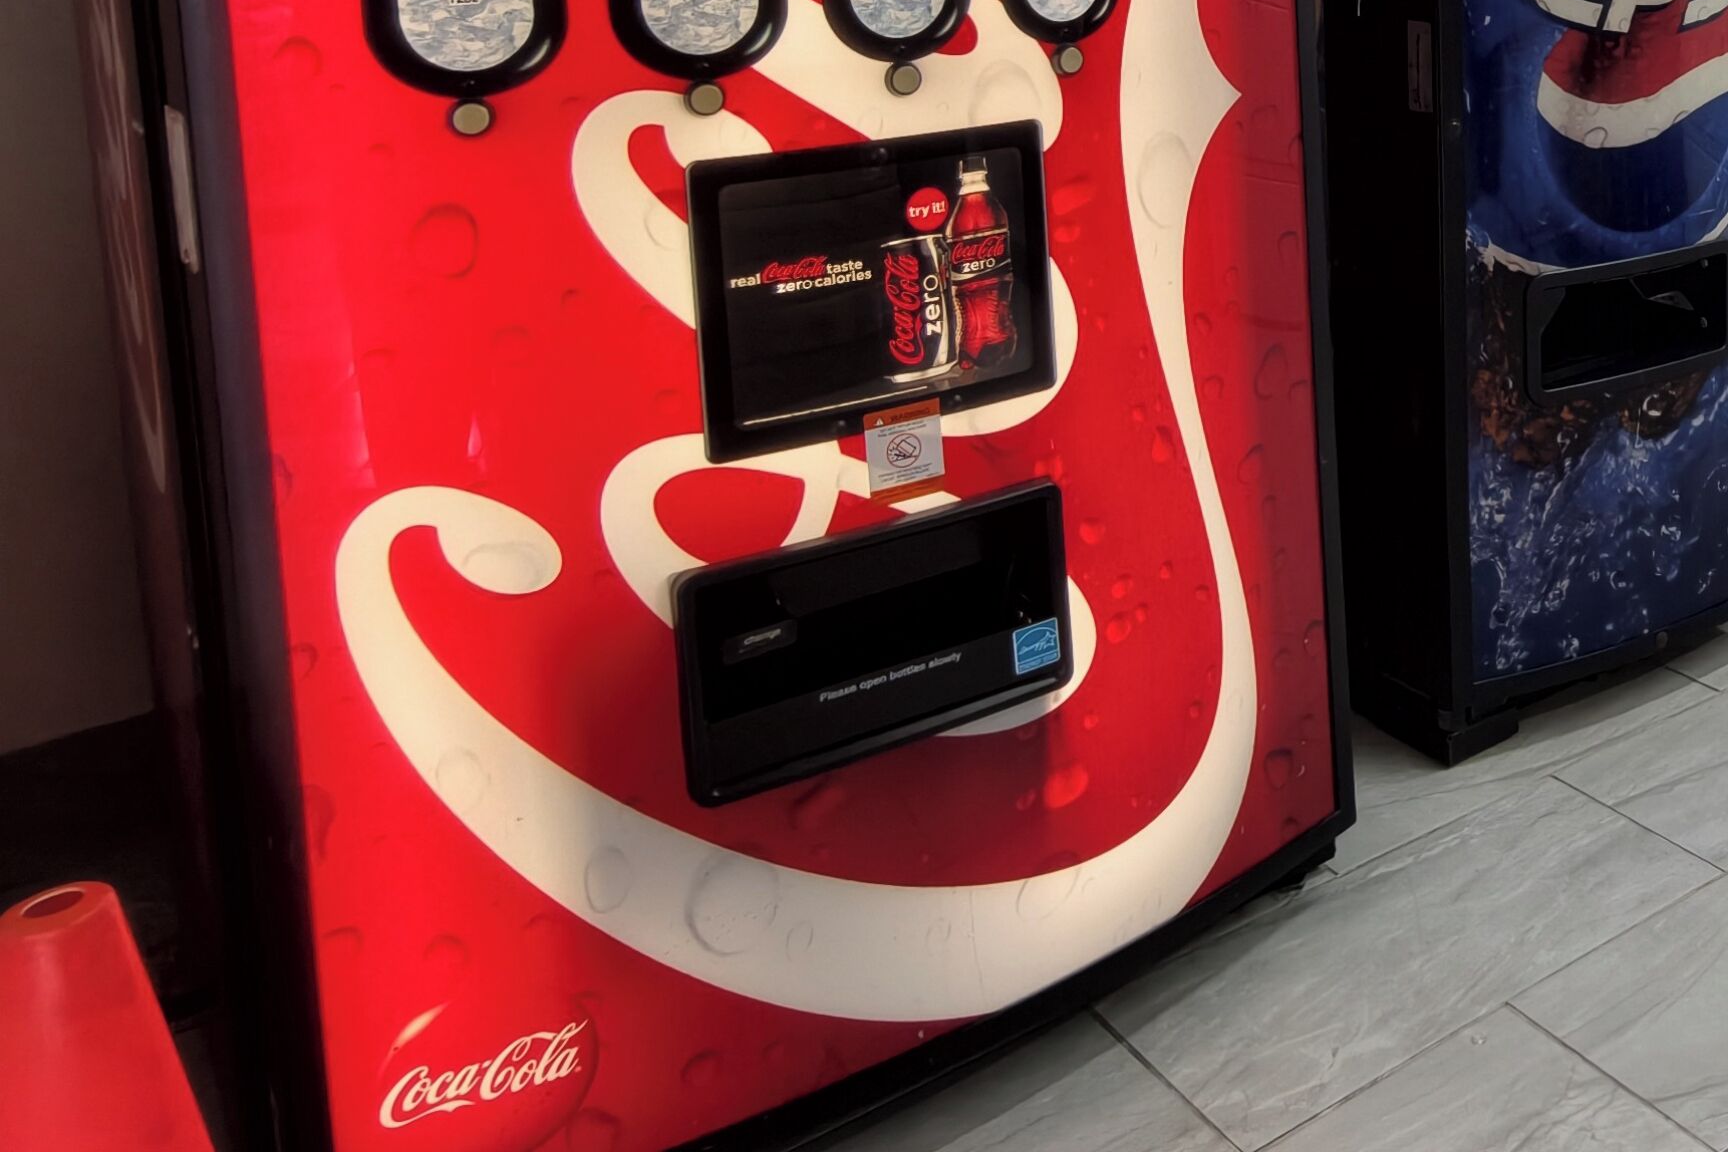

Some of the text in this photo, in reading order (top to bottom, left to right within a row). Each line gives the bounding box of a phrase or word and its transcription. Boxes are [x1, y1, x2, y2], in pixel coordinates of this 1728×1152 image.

[908, 201, 946, 218] try it!
[730, 272, 761, 288] real
[826, 260, 863, 275] taste
[962, 258, 996, 273] zero
[776, 270, 872, 294] zero calories
[923, 274, 942, 336] zero
[819, 651, 962, 702] Please open bottles slowly
[379, 1019, 588, 1129] Coca-Cola
